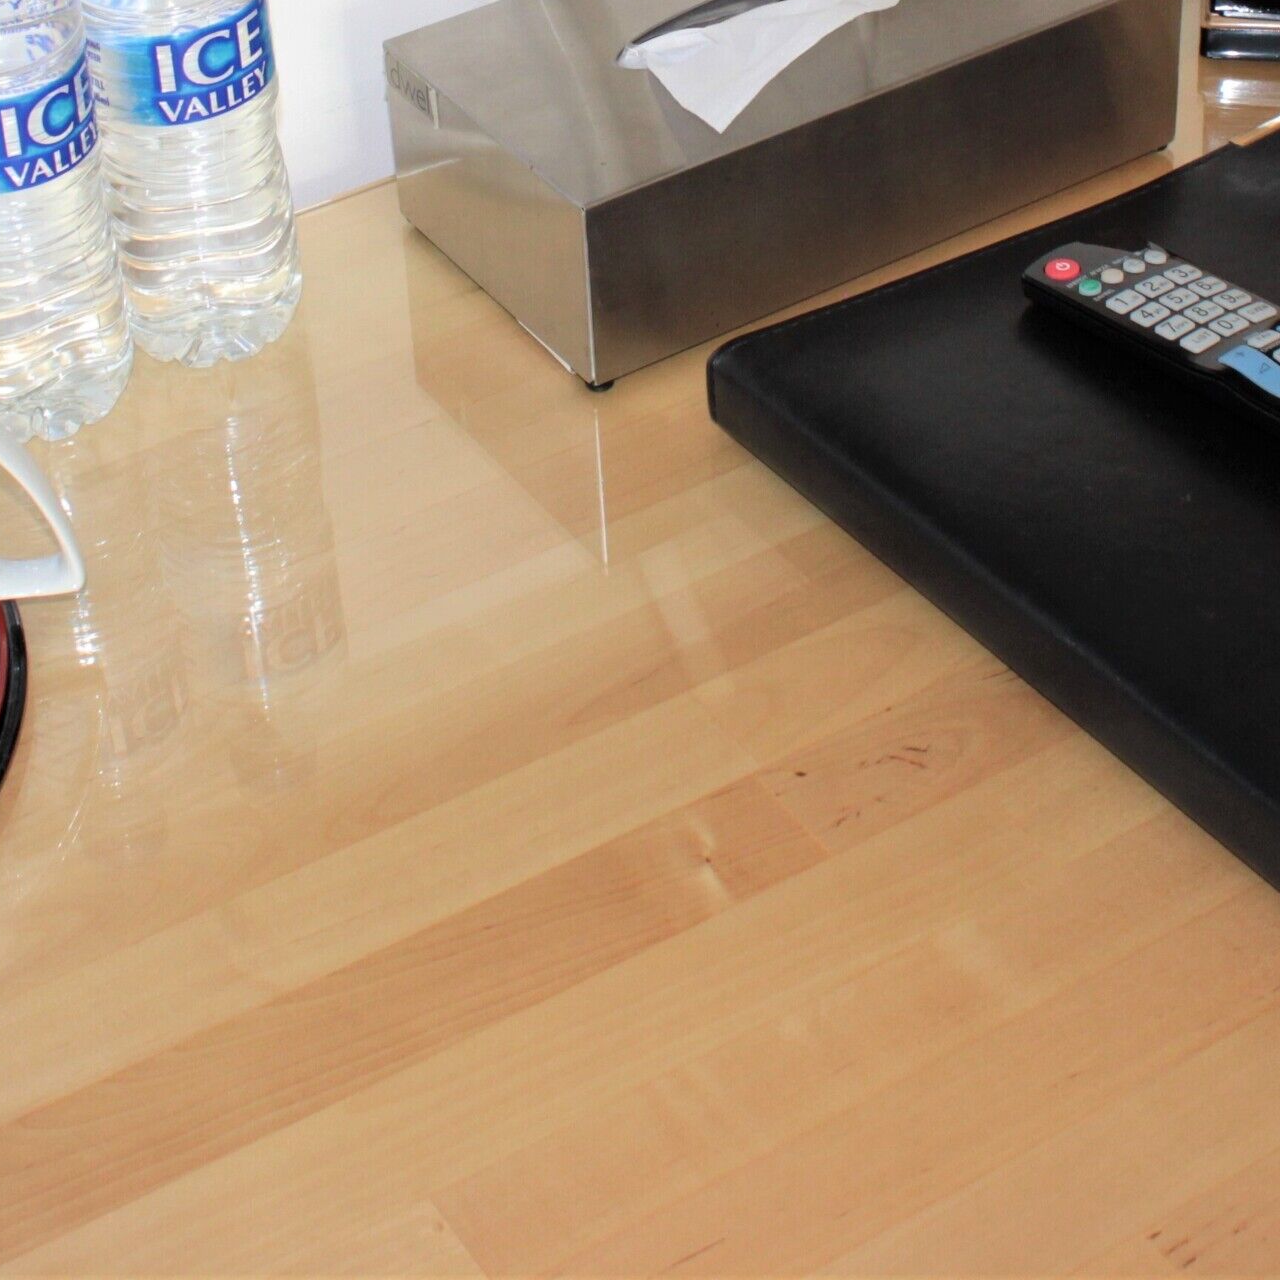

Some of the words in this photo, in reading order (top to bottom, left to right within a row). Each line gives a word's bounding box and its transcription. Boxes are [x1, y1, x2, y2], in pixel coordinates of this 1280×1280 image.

[156, 9, 263, 94] ICE
[0, 66, 94, 158] ICE
[159, 61, 268, 122] VALLEY
[5, 121, 98, 187] VALLEY
[1192, 307, 1208, 317] 8
[1217, 319, 1233, 330] 0
